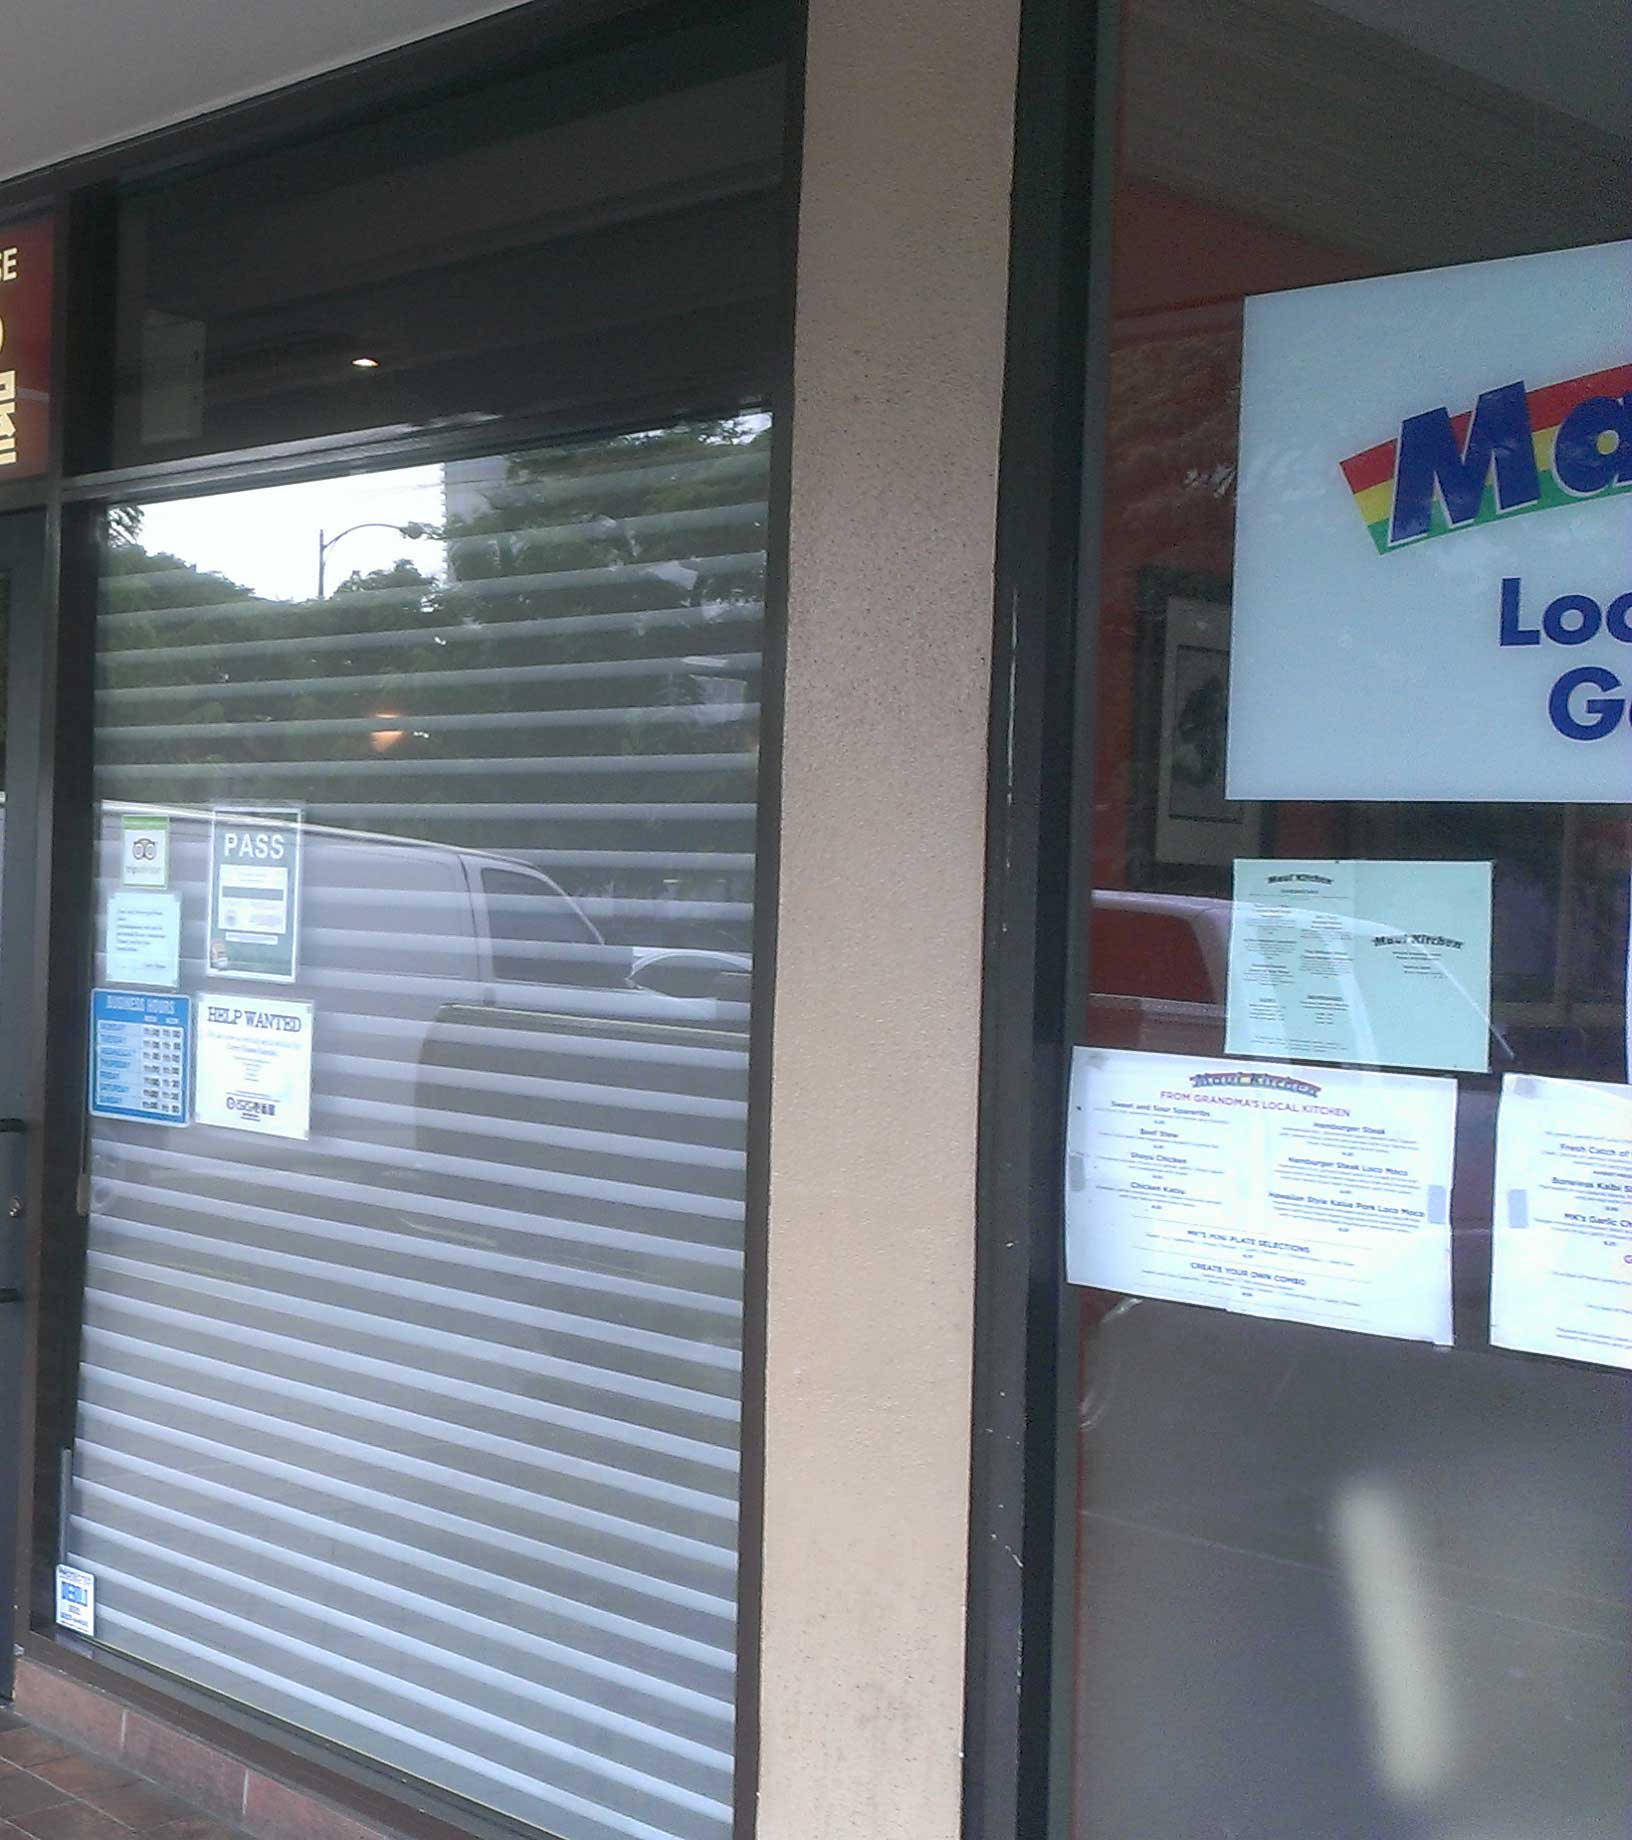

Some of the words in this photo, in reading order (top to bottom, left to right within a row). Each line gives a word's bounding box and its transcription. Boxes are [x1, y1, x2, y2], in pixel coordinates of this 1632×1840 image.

[224, 832, 285, 860] PASS
[207, 1006, 243, 1025] HELP
[244, 1010, 303, 1033] WANTED
[1159, 1090, 1191, 1102] FROM
[1193, 1093, 1259, 1109] GRANDMA'S
[1262, 1100, 1300, 1113] LOCAL
[1302, 1104, 1351, 1117] KITCHEN
